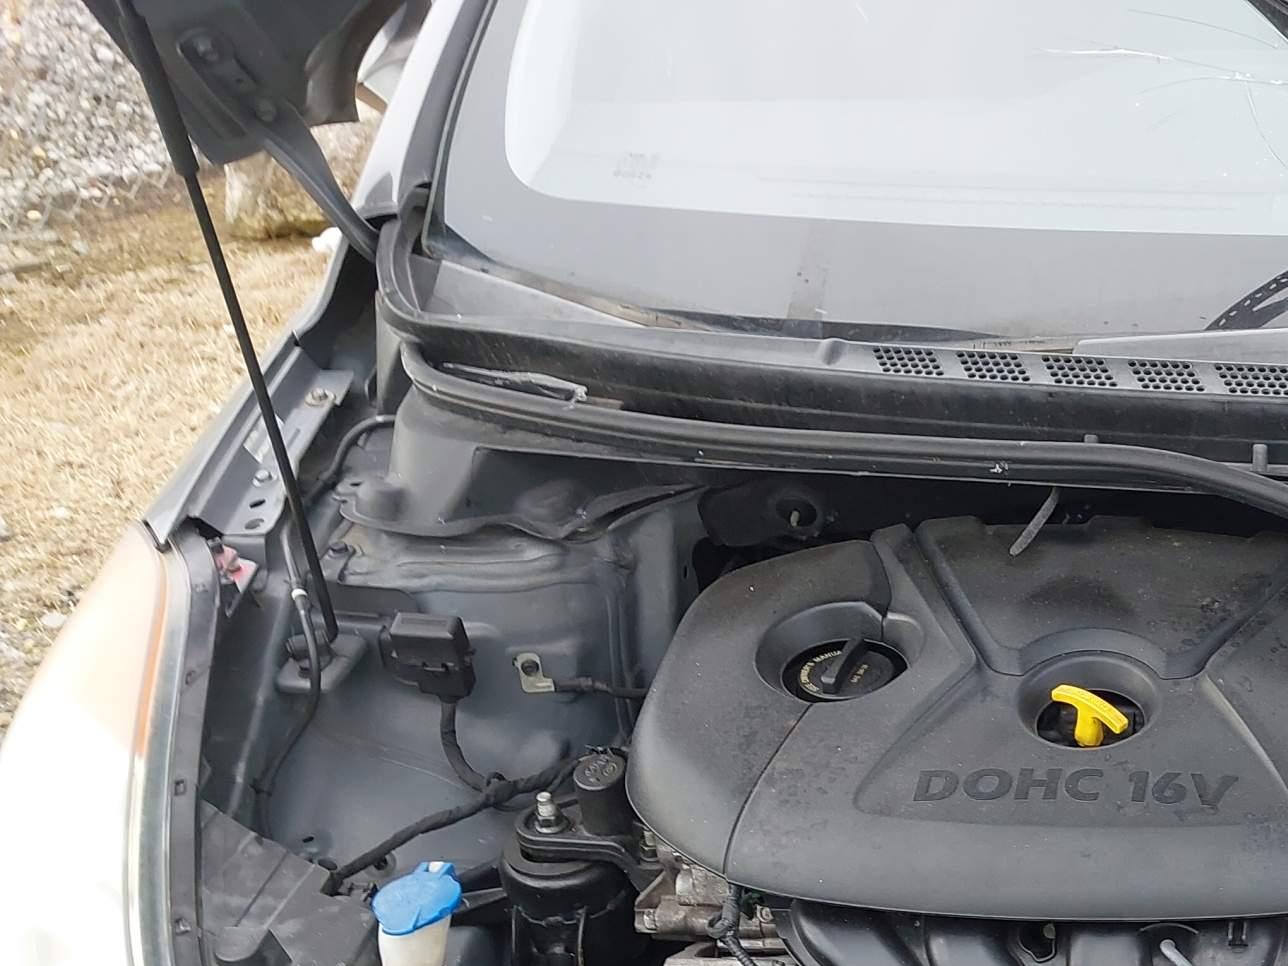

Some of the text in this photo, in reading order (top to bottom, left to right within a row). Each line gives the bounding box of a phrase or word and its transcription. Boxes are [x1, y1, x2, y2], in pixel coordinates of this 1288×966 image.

[813, 650, 842, 663] MANUA
[912, 768, 1239, 807] DOHC 16V
